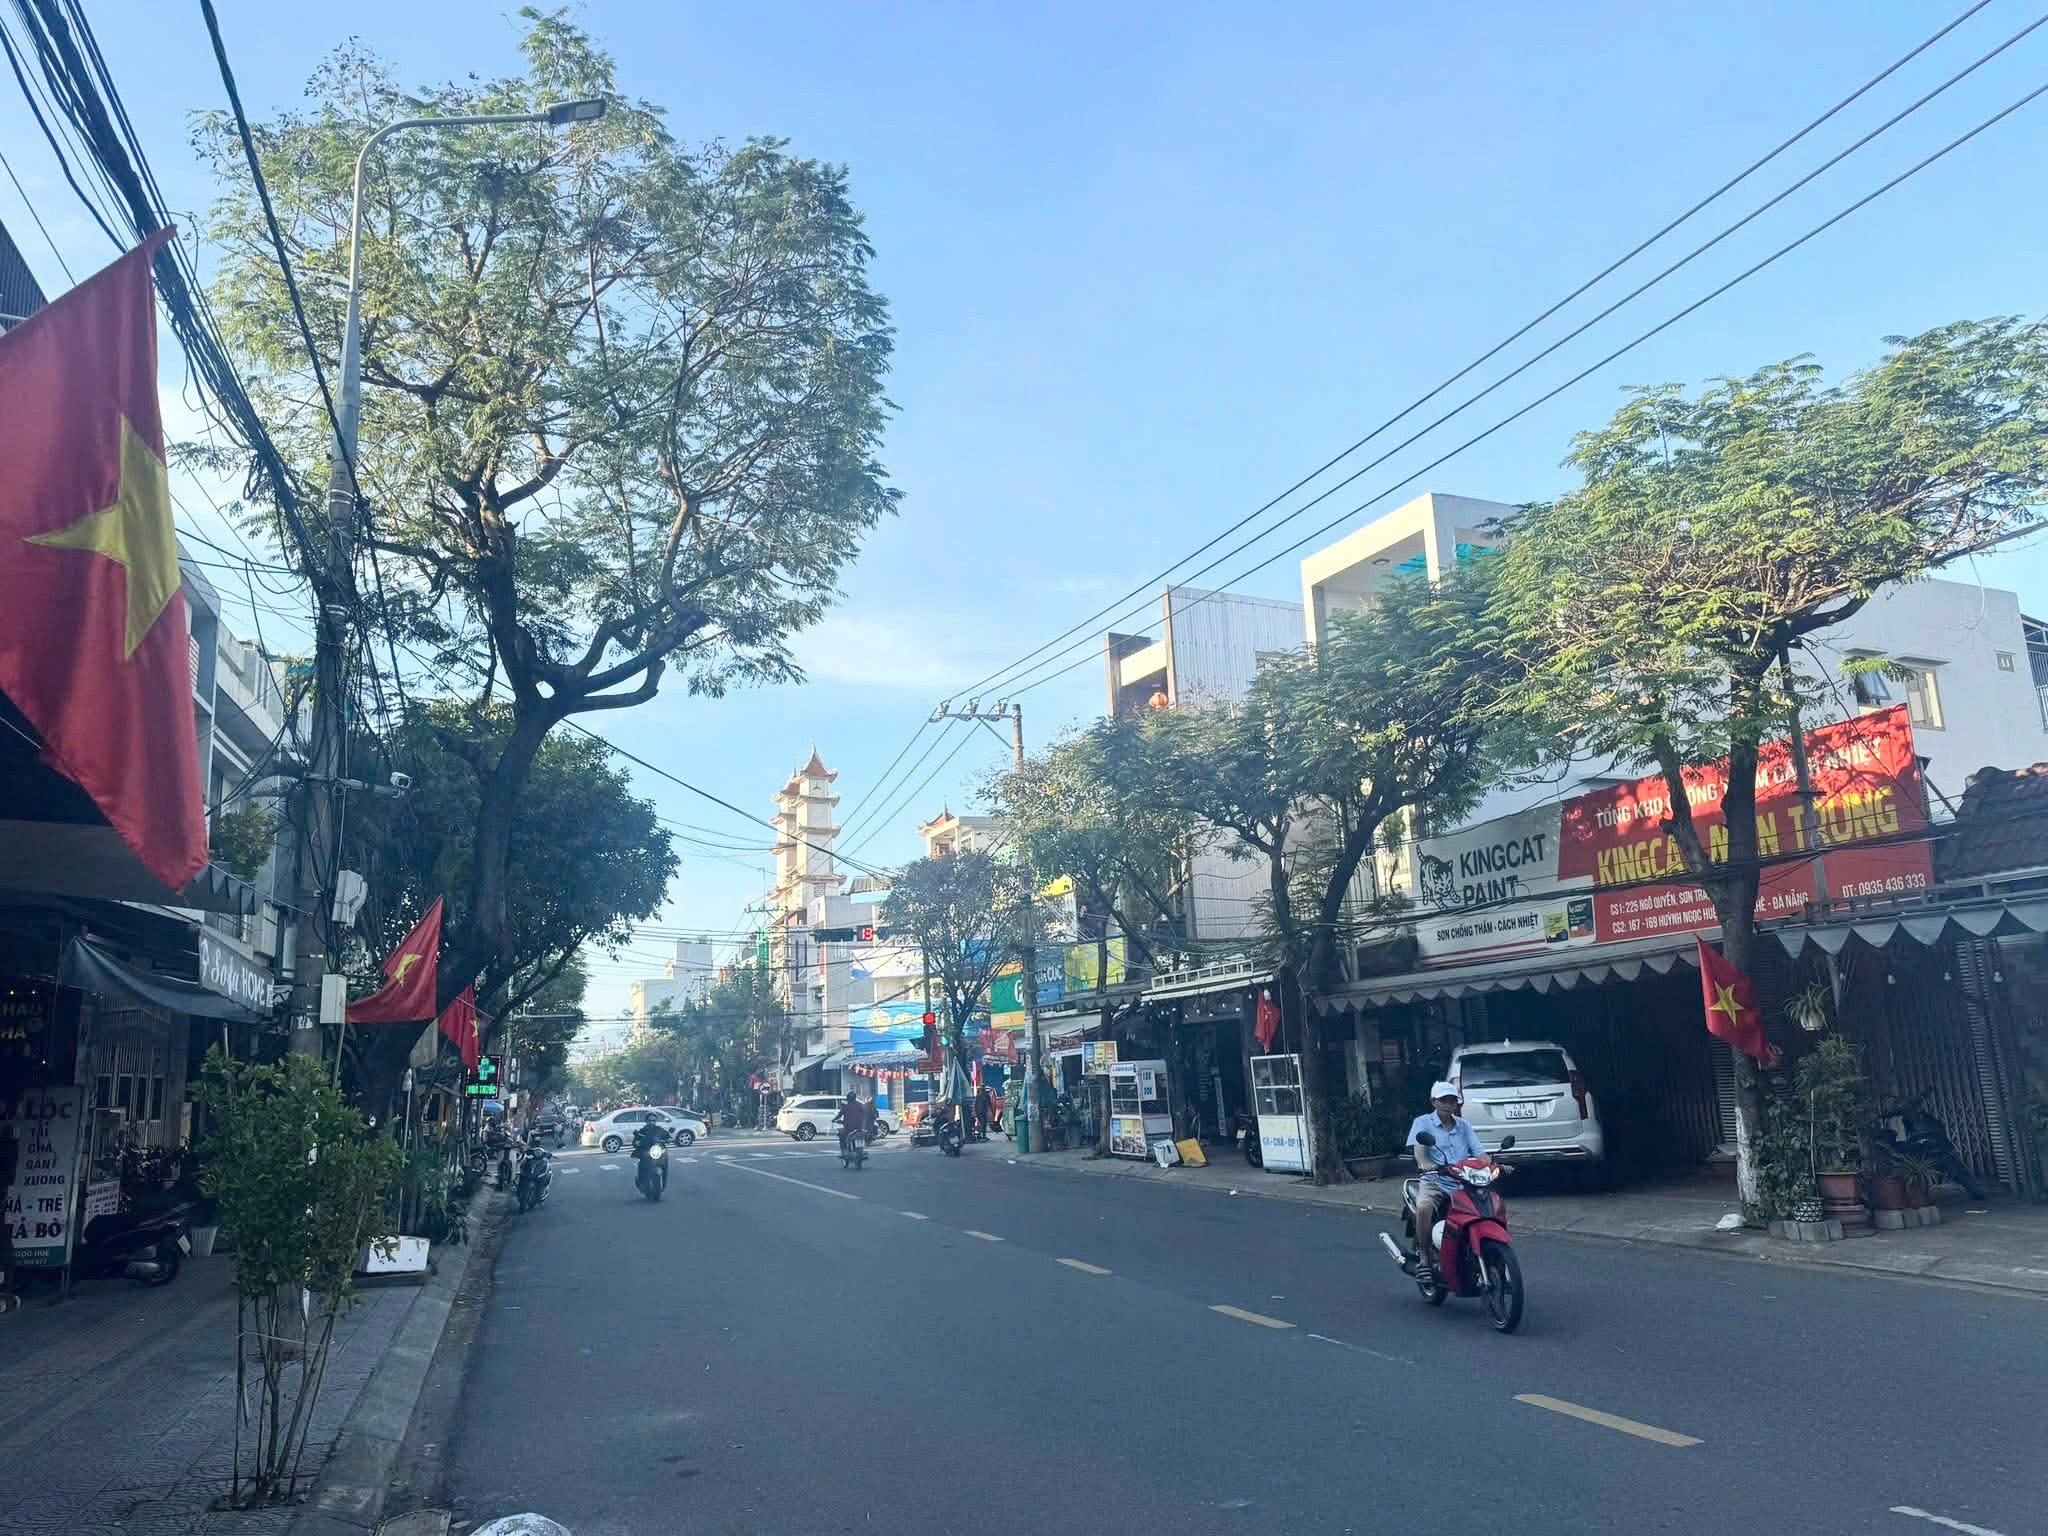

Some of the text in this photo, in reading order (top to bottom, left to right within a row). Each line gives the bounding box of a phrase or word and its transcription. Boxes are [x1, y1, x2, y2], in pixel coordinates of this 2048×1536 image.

[1595, 804, 1631, 828] TỔNG
[1634, 798, 1663, 819] KHO
[1598, 834, 1687, 886] KINGCA
[1788, 786, 1898, 849] TRUNG
[1460, 834, 1545, 878] KINGCAT
[1463, 875, 1518, 906] PAINT
[1859, 879, 1883, 896] 0935
[1885, 876, 1904, 892] 436
[1905, 872, 1926, 889] 333
[1626, 900, 1639, 913] 225
[1628, 919, 1640, 931] 167
[211, 949, 265, 1007] Sofa HOME
